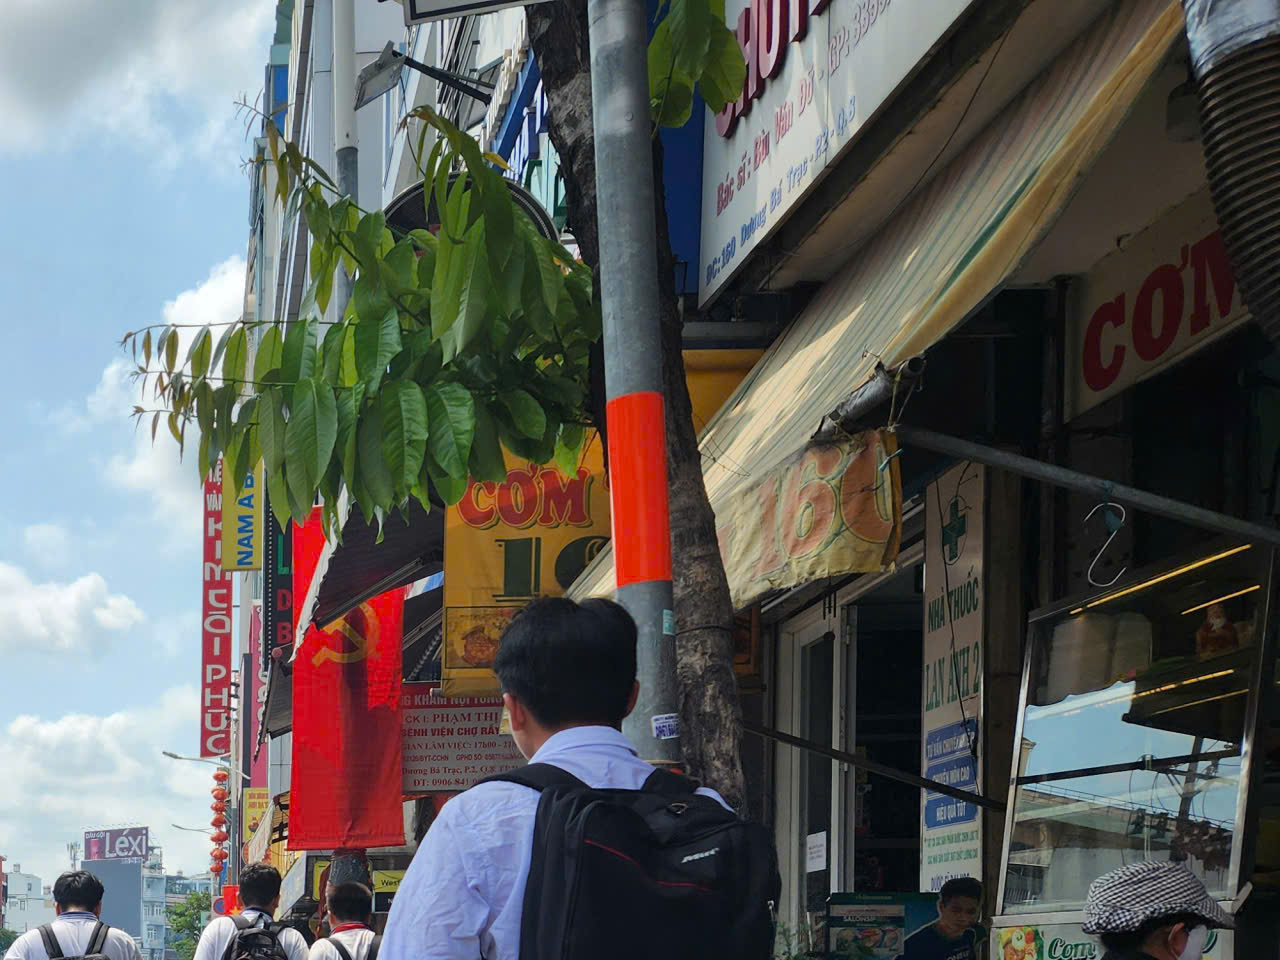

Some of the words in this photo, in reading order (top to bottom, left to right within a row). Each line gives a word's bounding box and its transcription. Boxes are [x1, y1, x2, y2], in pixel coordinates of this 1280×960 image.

[456, 463, 594, 530] CƠM
[236, 514, 255, 566] NAM
[928, 586, 945, 633] NHÀ
[925, 656, 945, 712] LAN
[972, 640, 980, 694] 2
[430, 726, 454, 738] VIỆN
[457, 726, 478, 736] CHỢ
[432, 712, 471, 725] PHẠM
[474, 712, 499, 723] THỊ
[413, 778, 429, 787] ĐT:
[105, 828, 147, 858] Léxi
